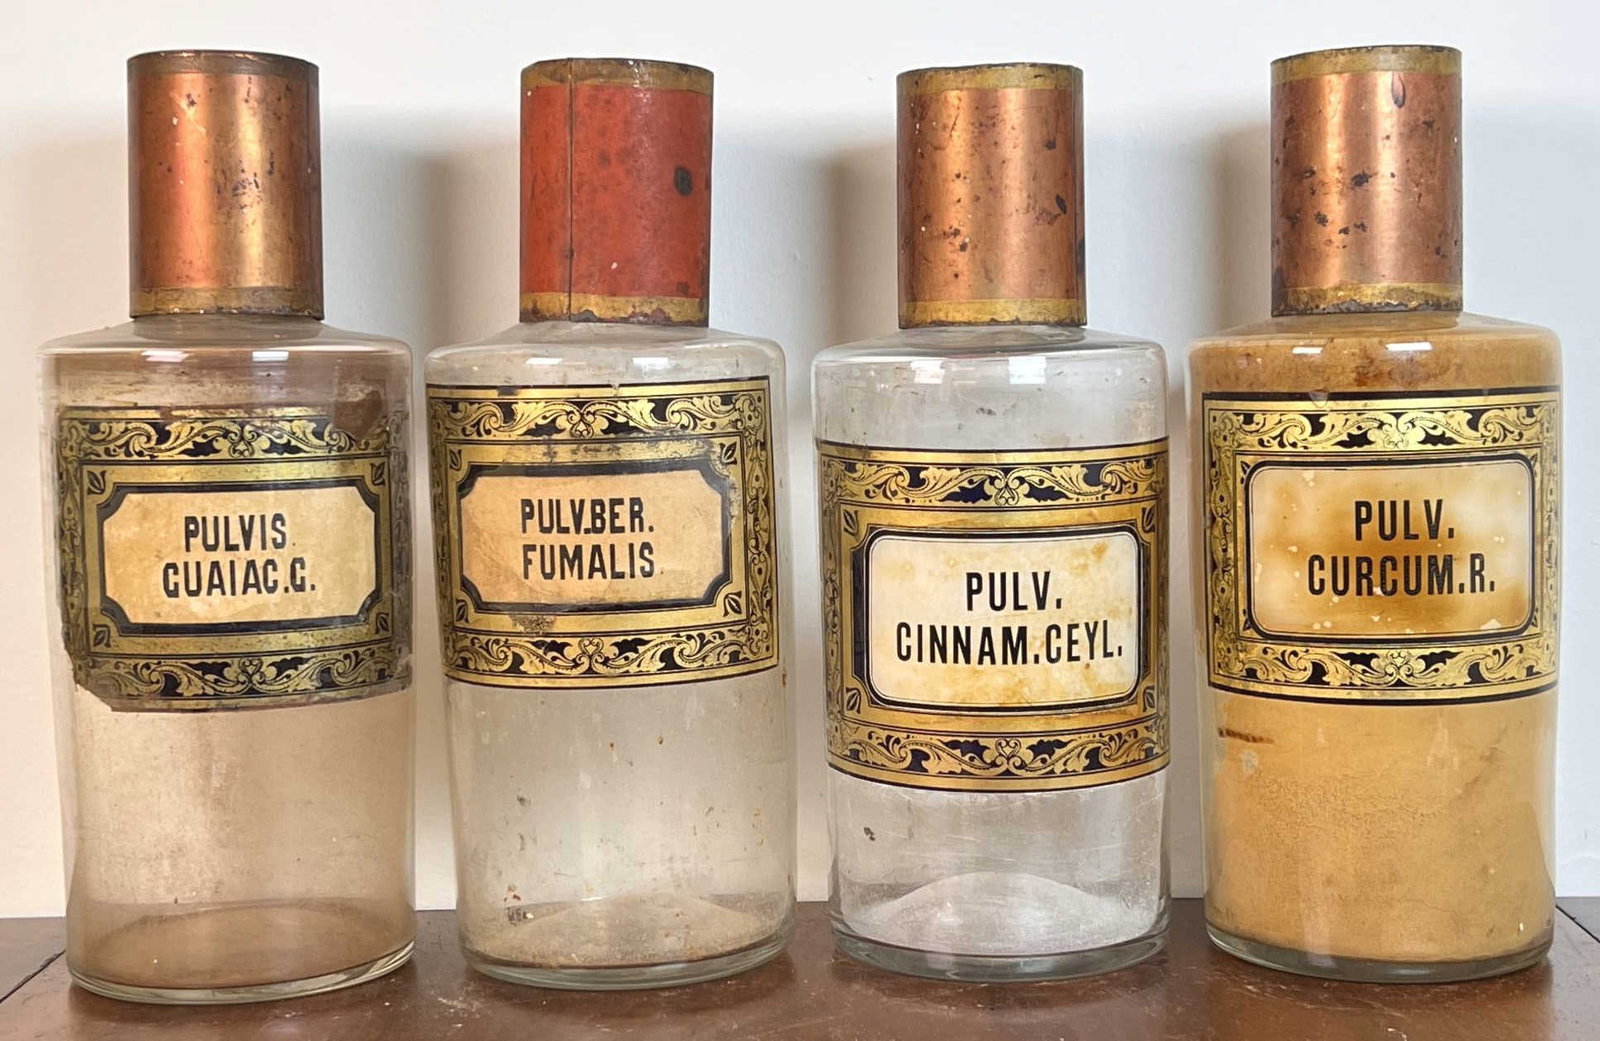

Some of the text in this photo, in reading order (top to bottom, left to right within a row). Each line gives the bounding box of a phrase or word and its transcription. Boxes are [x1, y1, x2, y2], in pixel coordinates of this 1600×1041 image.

[184, 512, 288, 553] PULVIS
[1353, 497, 1456, 542] PULV.
[521, 540, 656, 581] FUMALIS
[1307, 552, 1496, 598] CURCUM.R.
[965, 569, 1064, 613] PULV.
